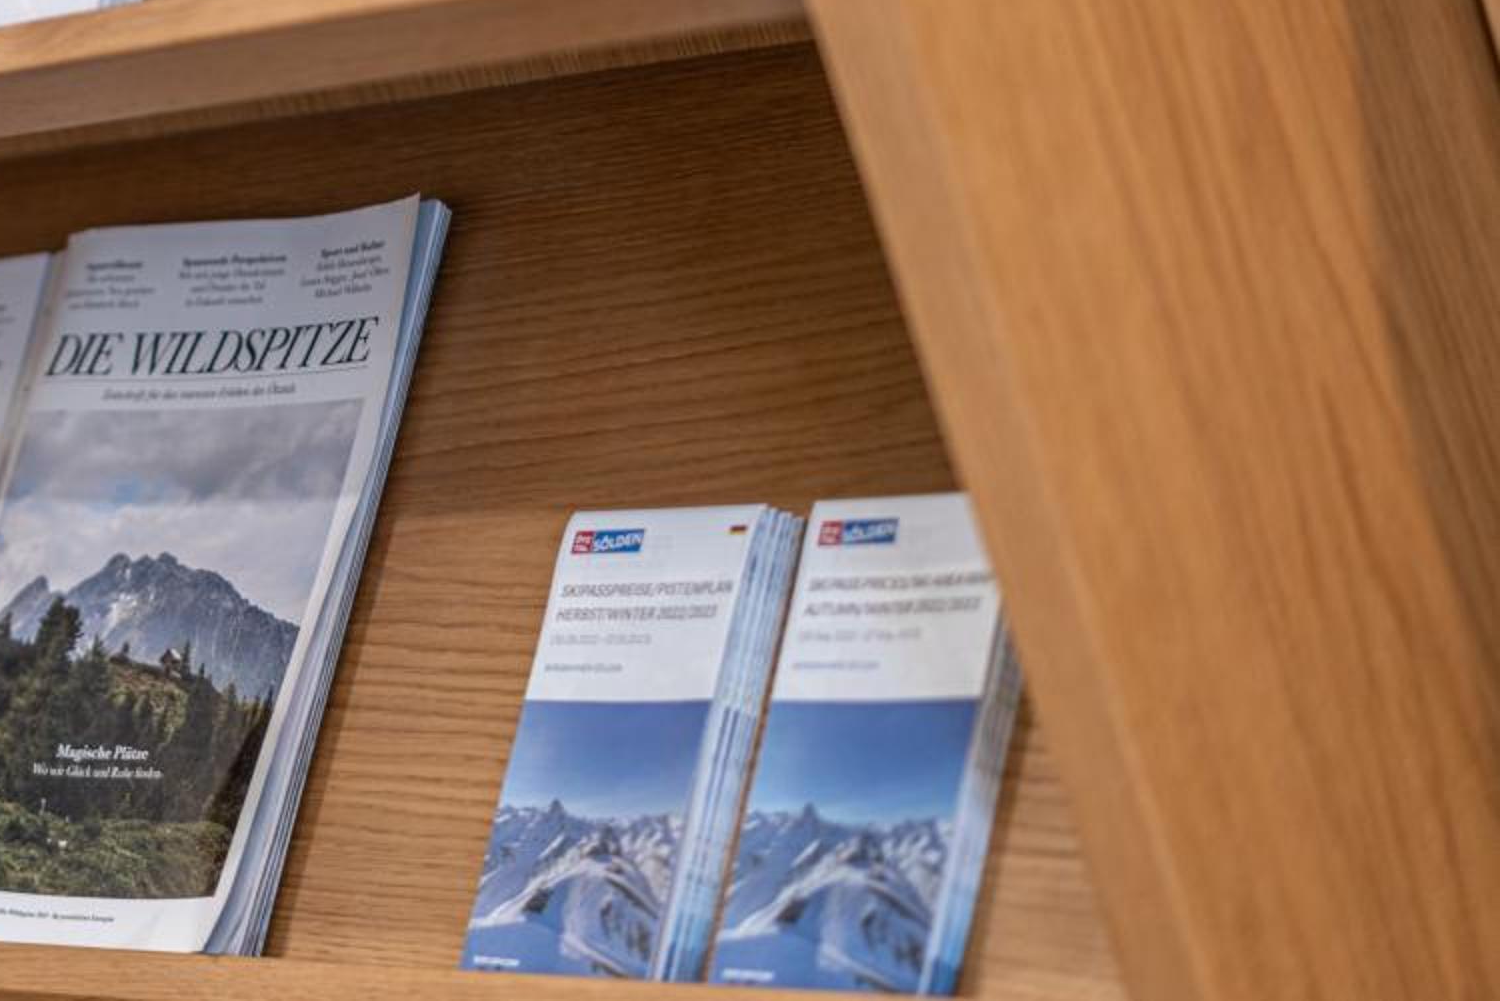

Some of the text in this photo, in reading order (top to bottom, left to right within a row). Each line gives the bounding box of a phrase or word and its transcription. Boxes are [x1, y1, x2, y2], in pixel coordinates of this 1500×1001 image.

[46, 314, 380, 377] DIE WILDSPITZE
[593, 531, 642, 552] SÖLDEN
[56, 743, 149, 762] Magische Plätze
[33, 762, 48, 776] Wo
